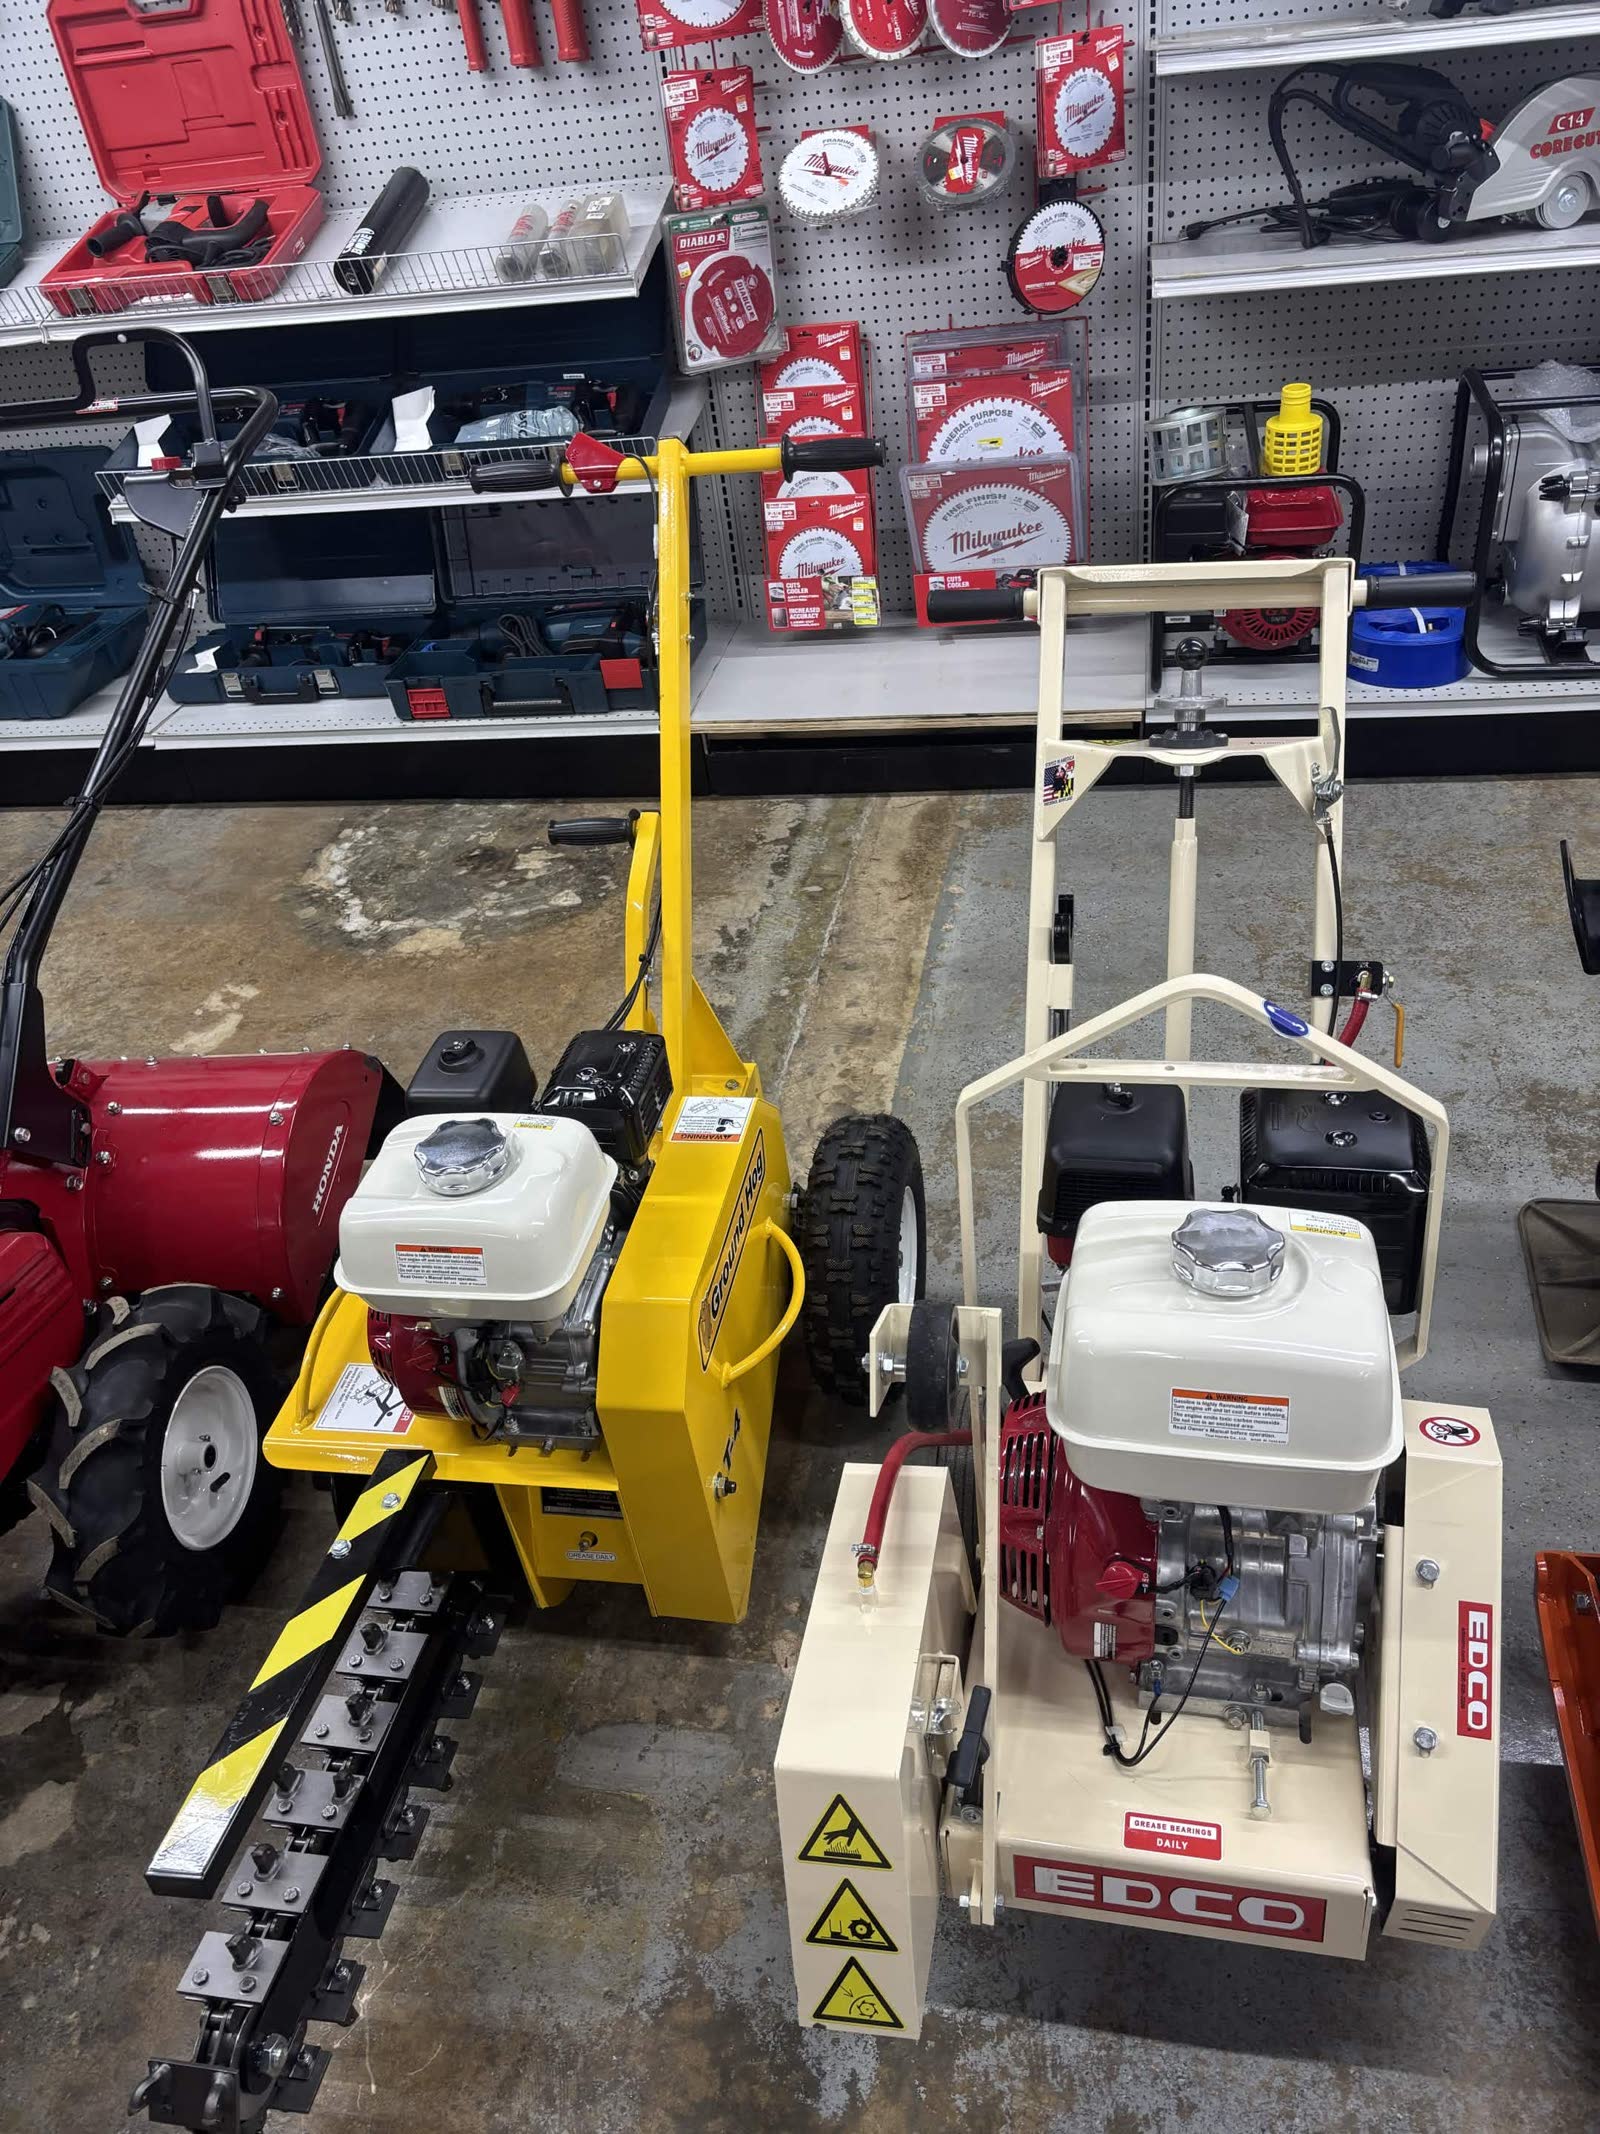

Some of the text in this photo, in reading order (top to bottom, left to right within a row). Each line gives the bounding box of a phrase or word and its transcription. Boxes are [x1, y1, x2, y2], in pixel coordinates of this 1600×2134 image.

[1066, 93, 1105, 122] Milwaukee
[1556, 112, 1585, 130] C14
[693, 132, 737, 159] Milwaukee
[822, 137, 855, 148] FRAMING
[962, 133, 980, 185] Milwaukee
[1033, 216, 1053, 234] ULTRA
[350, 233, 373, 255] BORE
[679, 234, 716, 249] DIABLO
[736, 280, 752, 313] DIABLO
[816, 330, 850, 346] Milwaukee
[1005, 347, 1045, 365] Milwaukee
[1028, 377, 1069, 395] Milwaukee
[822, 389, 856, 405] Milwaukee
[940, 419, 971, 456] GENERAL
[970, 409, 1014, 423] PURPOSE
[954, 417, 999, 444] WOOD BLADE
[793, 475, 819, 488] CEMENT
[1027, 467, 1067, 482] Milwaukee
[828, 500, 865, 517] Milwaukee
[941, 493, 1008, 522] FINE FINISH
[954, 500, 999, 519] WOOD BLADE
[793, 543, 806, 554] FINE
[805, 536, 825, 545] FINISH
[944, 521, 1044, 556] Milwaukee
[795, 557, 847, 579] Milwaukee
[947, 581, 971, 589] COOLER
[312, 1124, 344, 1215] HONDA
[710, 1150, 764, 1320] Ground Hog
[1305, 1226, 1338, 1236] CAUTION
[1217, 1393, 1248, 1402] WARNING
[1219, 1402, 1246, 1410] flammable
[1262, 1411, 1286, 1419] refueling.
[723, 1407, 741, 1472] T-4
[1249, 1431, 1276, 1439] operation.
[568, 1552, 595, 1560] GREASE
[1467, 1610, 1489, 1730] EDCO
[1134, 1819, 1213, 1837] GREASE BEARINGS
[1156, 1837, 1189, 1850] DAILY
[1033, 1865, 1305, 1931] EDCO
